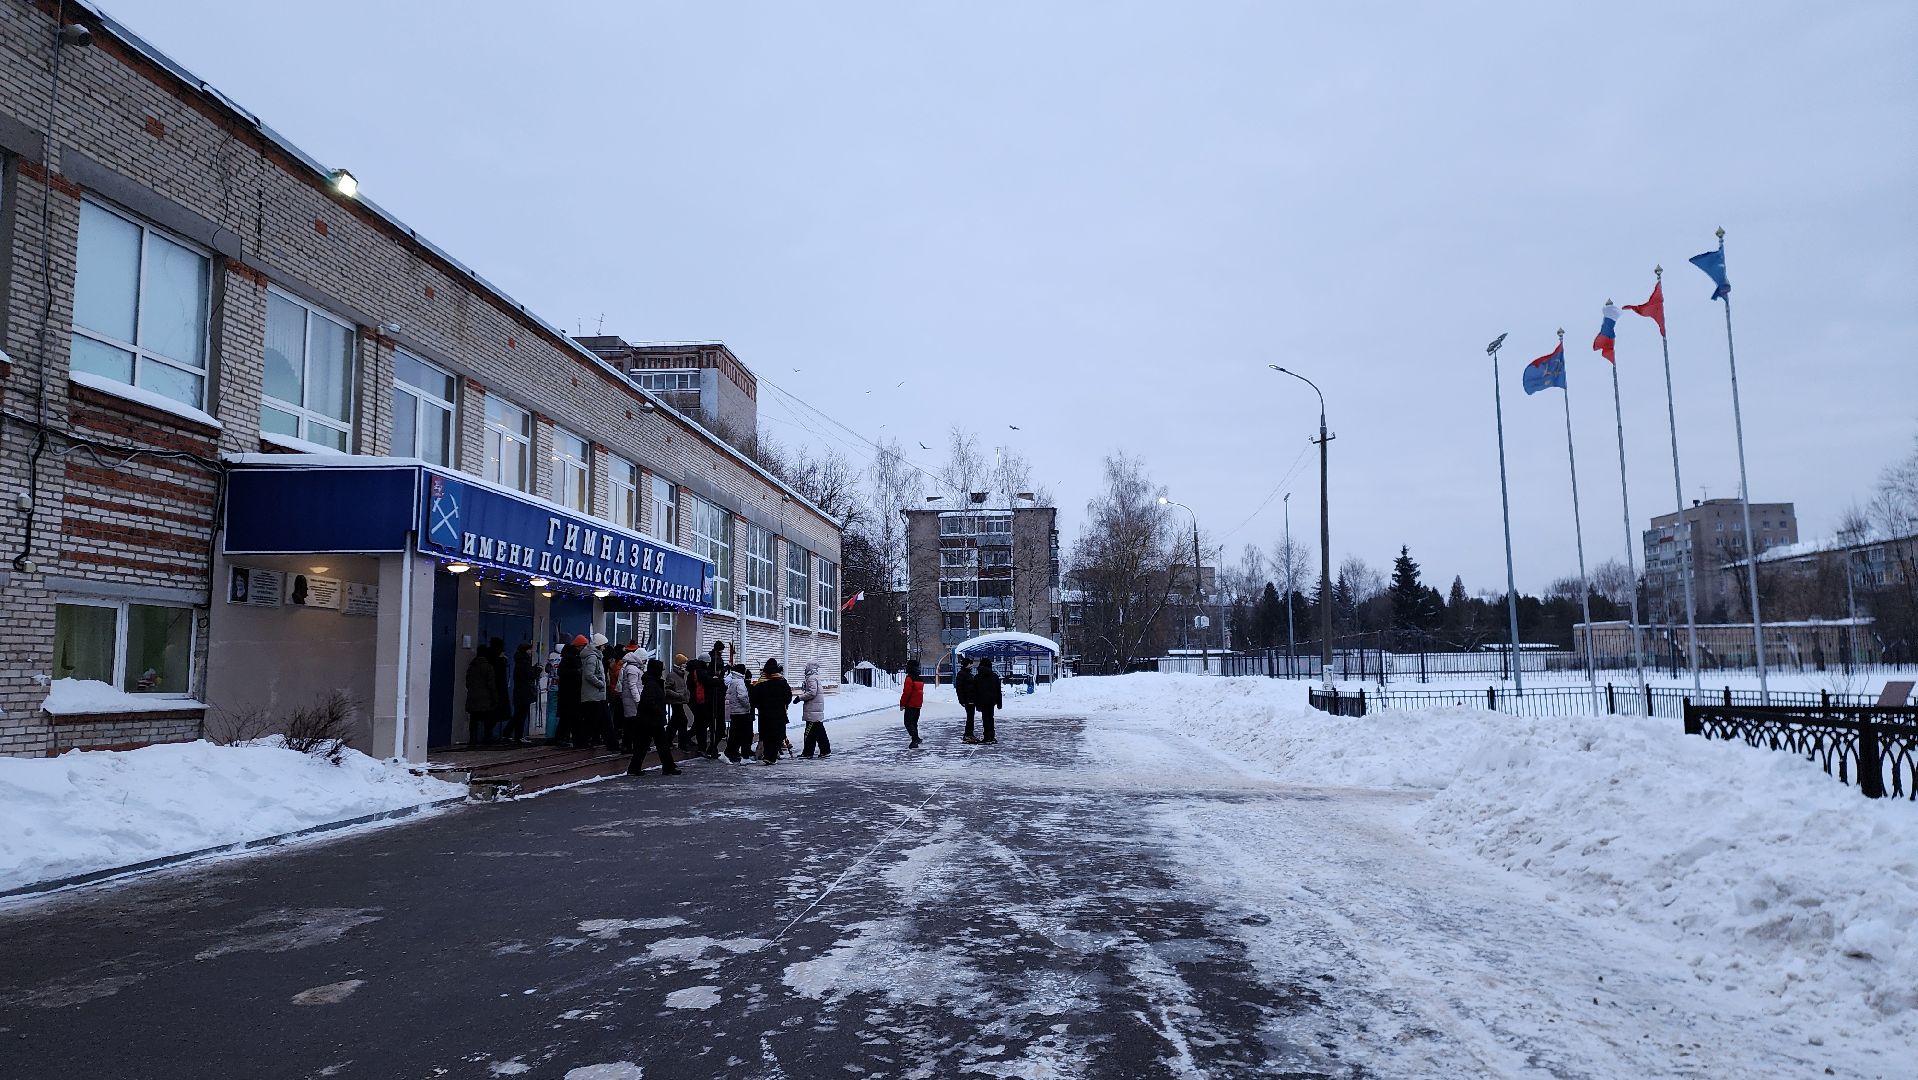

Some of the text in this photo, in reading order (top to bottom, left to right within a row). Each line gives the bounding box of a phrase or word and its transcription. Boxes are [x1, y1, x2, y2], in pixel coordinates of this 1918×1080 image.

[463, 531, 702, 602] ИМЕНИ ПОДОЛЬСКИХ КУРСАНТОВ
[546, 517, 666, 575] ГИМНАЗИЯ
